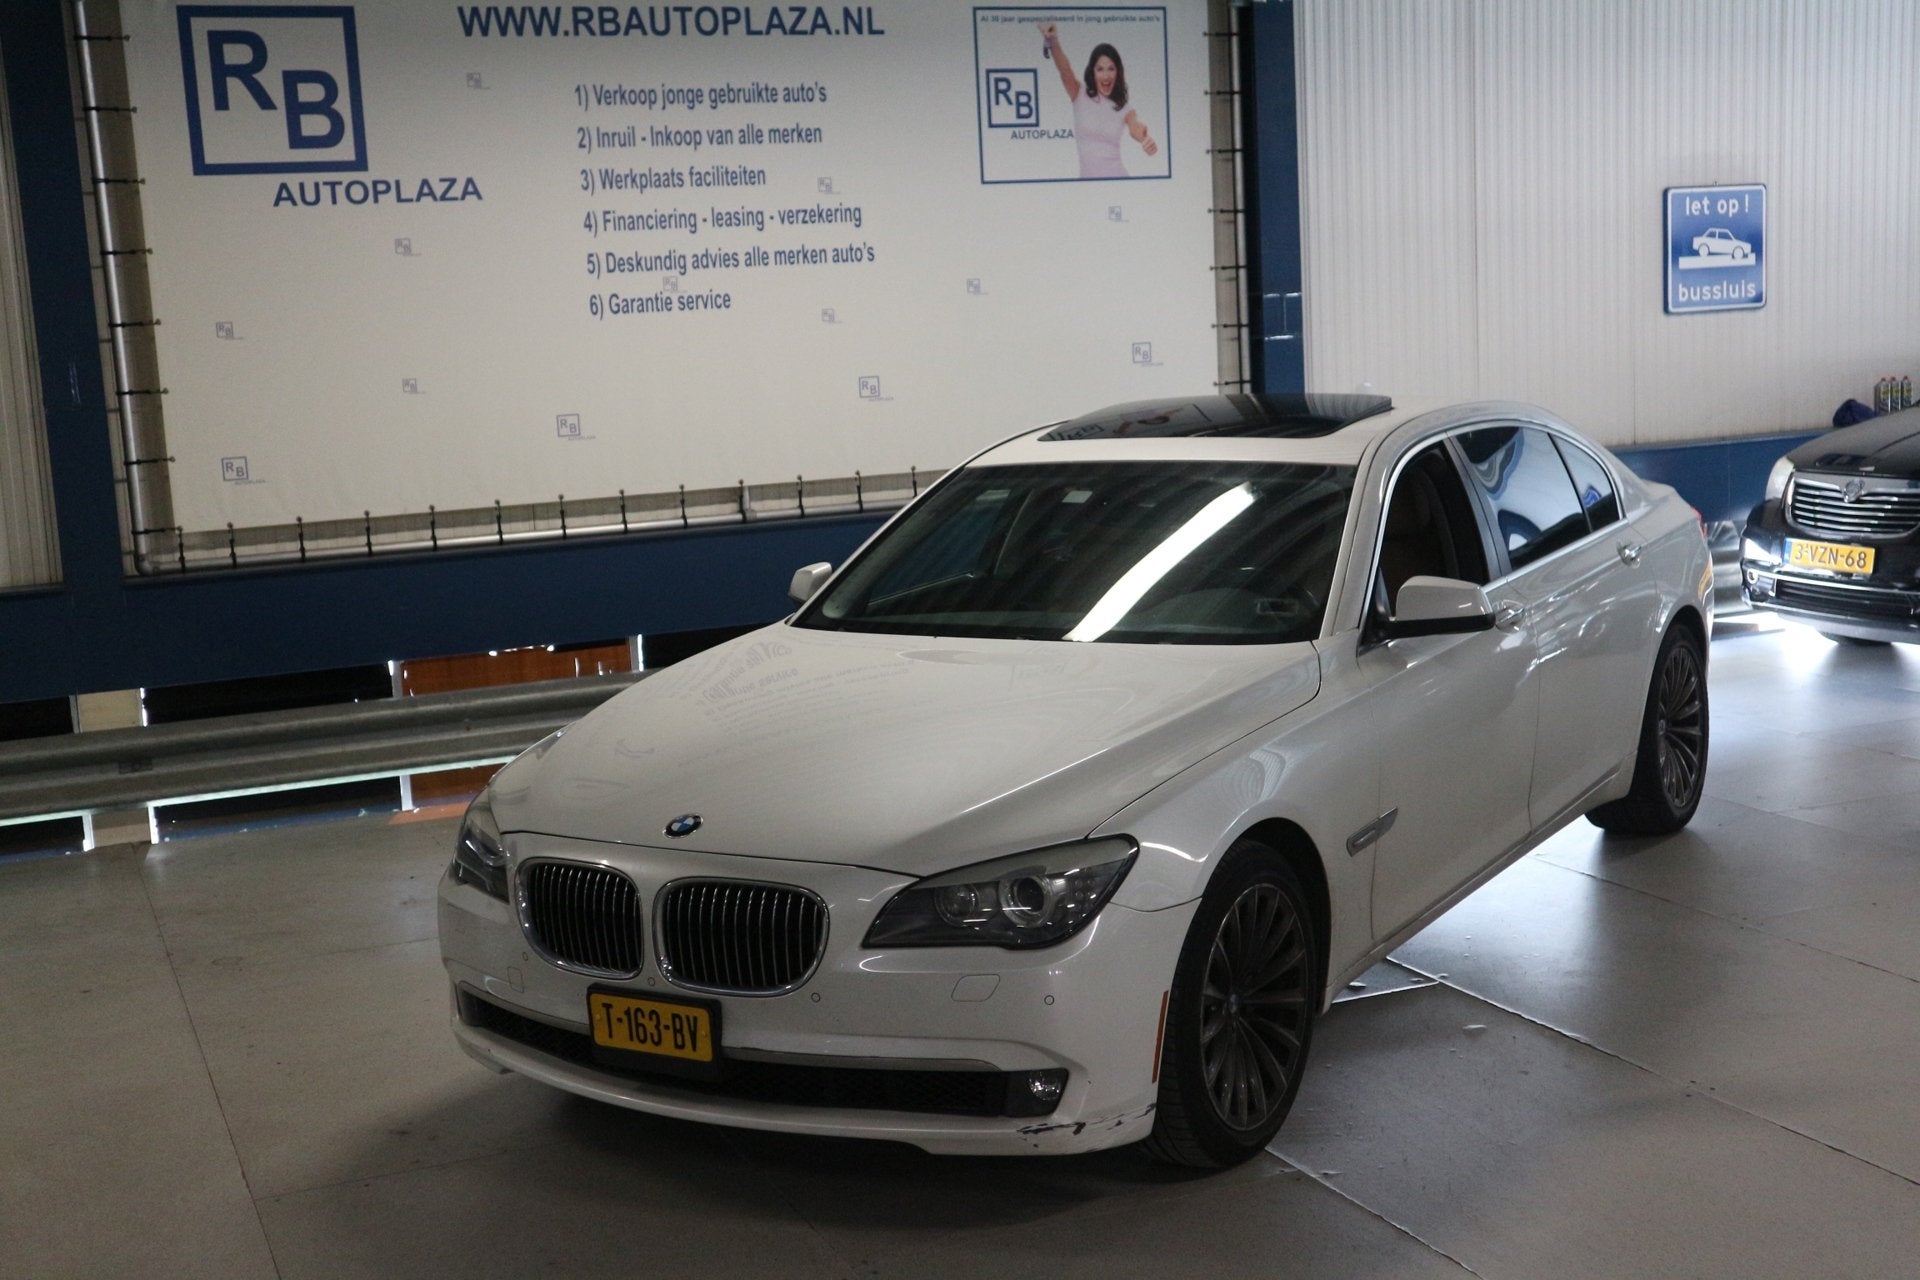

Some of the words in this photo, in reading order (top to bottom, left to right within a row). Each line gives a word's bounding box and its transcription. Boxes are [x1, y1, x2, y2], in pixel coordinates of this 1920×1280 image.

[458, 6, 885, 37] WWW.RBAUTOPLAZA.NL
[575, 84, 589, 112] 1)
[592, 84, 657, 110] Verkoop
[661, 83, 704, 110] jonge
[708, 82, 778, 109] gebruikte
[782, 81, 827, 103] auto's
[577, 126, 592, 154] 2)
[597, 126, 636, 148] Inruil
[650, 125, 702, 151] Inkoop
[706, 129, 733, 145] van
[738, 123, 763, 144] alle
[768, 122, 823, 143] merken
[1011, 129, 1074, 140] AUTOPLAZA
[272, 176, 483, 207] AUTOPLAZA
[580, 168, 595, 196] 3)
[598, 167, 685, 194] Werkplaats
[688, 165, 766, 188] faciliteiten
[583, 210, 598, 238] 4)
[602, 208, 697, 234] Financiering
[711, 205, 765, 232] leasing
[778, 202, 862, 228] verzekering
[1685, 195, 1710, 216] let
[1717, 198, 1739, 218] op
[587, 252, 601, 280] 5)
[605, 250, 688, 276] Deskundig
[691, 247, 740, 270] advies
[744, 246, 770, 268] alle
[774, 244, 828, 266] merken
[832, 241, 876, 264] auto's
[589, 293, 604, 321] 6)
[608, 291, 673, 315] Garantie
[677, 288, 732, 311] service
[1679, 280, 1756, 302] bussluis
[601, 1002, 698, 1051] T-163-BV
